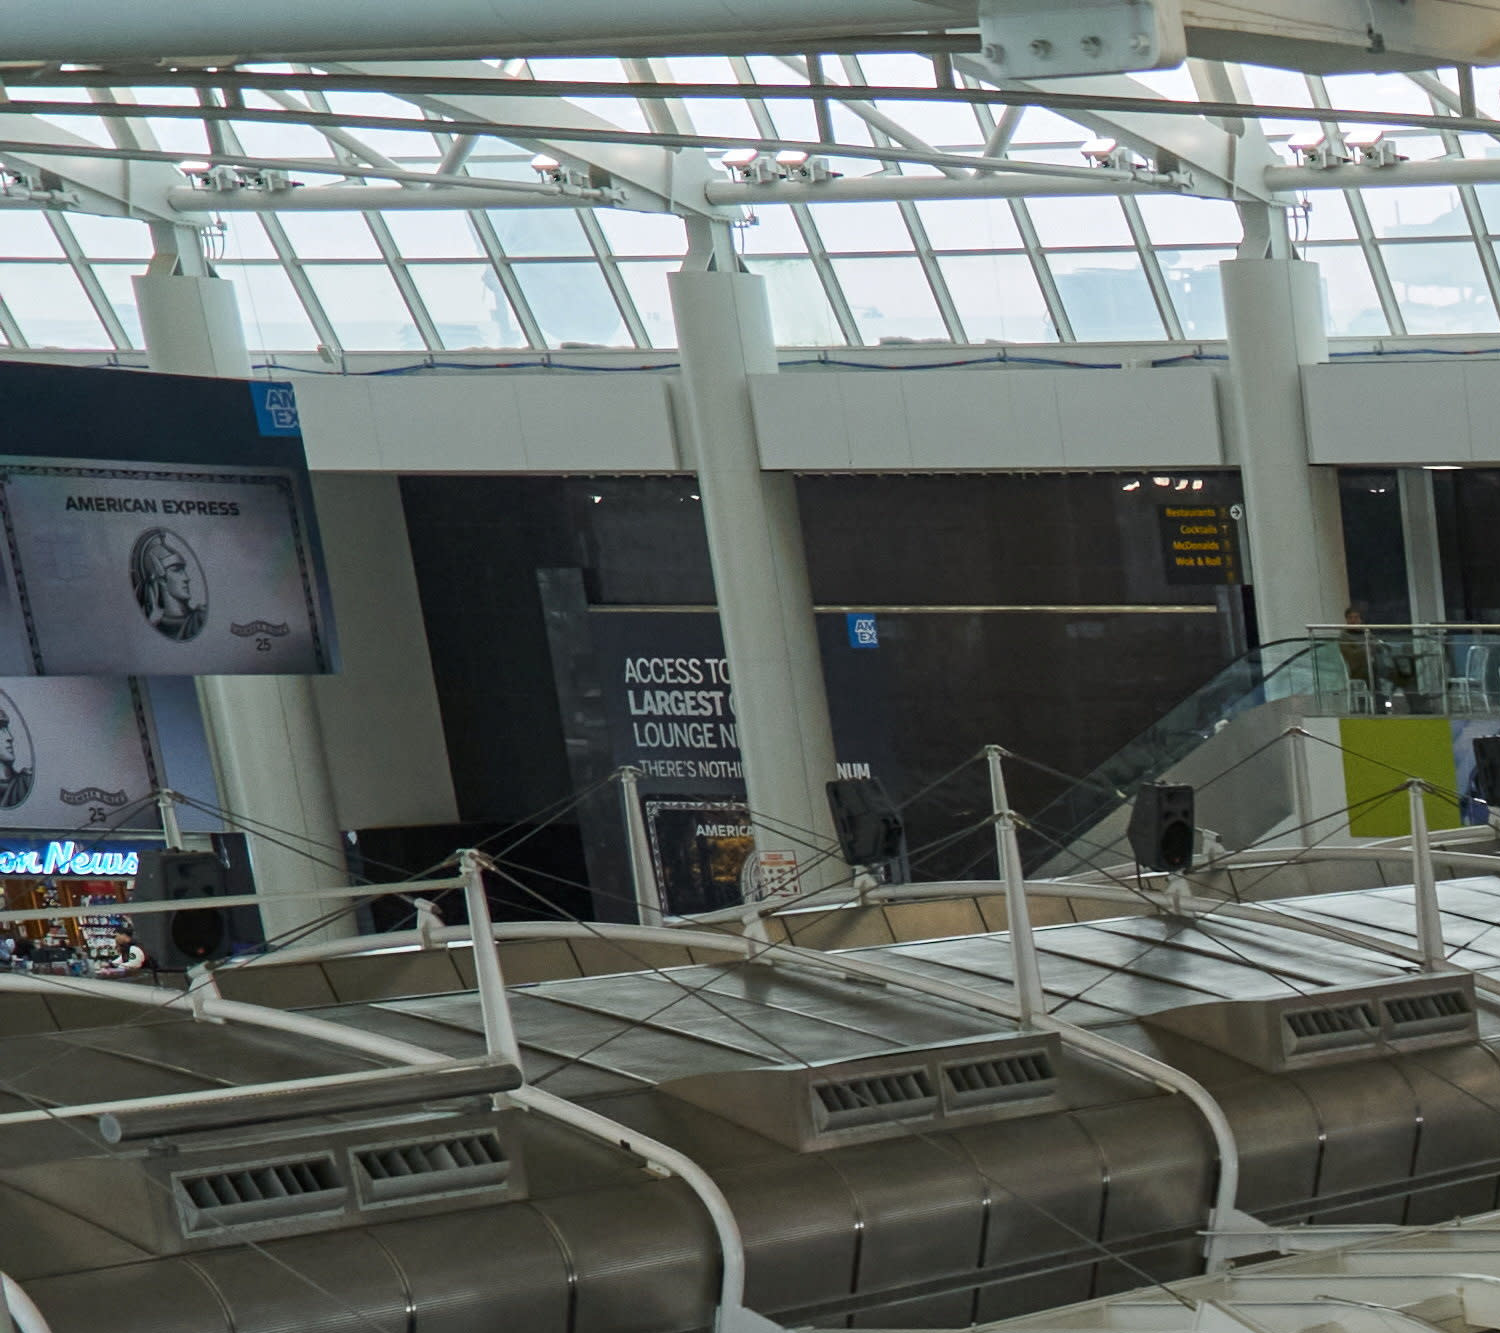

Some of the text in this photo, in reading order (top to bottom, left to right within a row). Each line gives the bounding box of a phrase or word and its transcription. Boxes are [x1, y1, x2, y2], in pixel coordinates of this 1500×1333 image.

[65, 495, 241, 517] AMERICAN EXPRESS
[256, 637, 272, 651] 25
[625, 657, 704, 684] ACCESS
[627, 690, 725, 717] LARGEST
[633, 722, 721, 749] LOUNGE
[639, 759, 697, 778] THERE'S
[88, 806, 107, 823] 25
[43, 840, 139, 876] News
